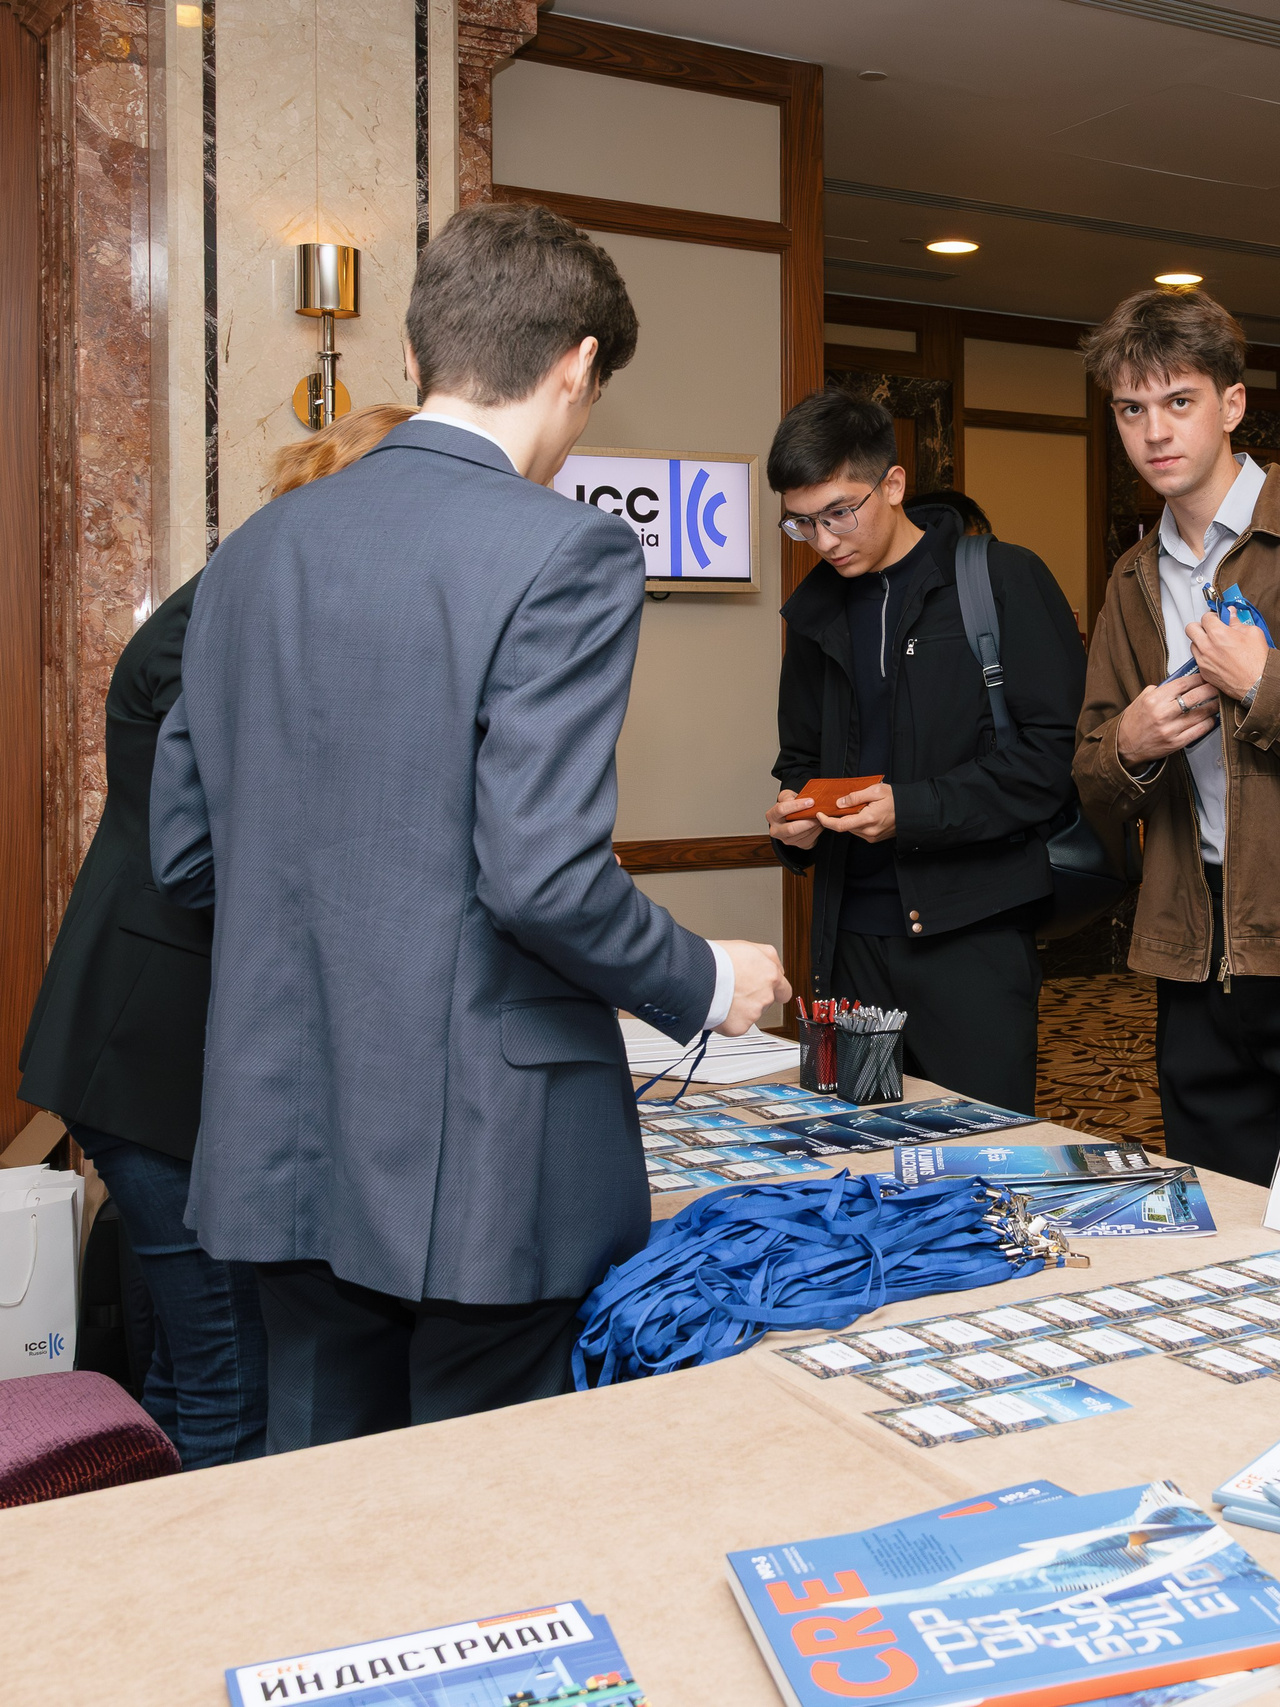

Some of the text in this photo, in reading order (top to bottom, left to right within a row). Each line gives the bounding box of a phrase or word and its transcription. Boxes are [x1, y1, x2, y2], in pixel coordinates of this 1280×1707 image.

[25, 1340, 48, 1352] ICC
[28, 1349, 48, 1358] Russia
[1235, 1472, 1263, 1490] CRE
[765, 1570, 919, 1699] CRE
[256, 1660, 312, 1679] CRE
[260, 1619, 575, 1702] ИНДАСТРИАЛ
